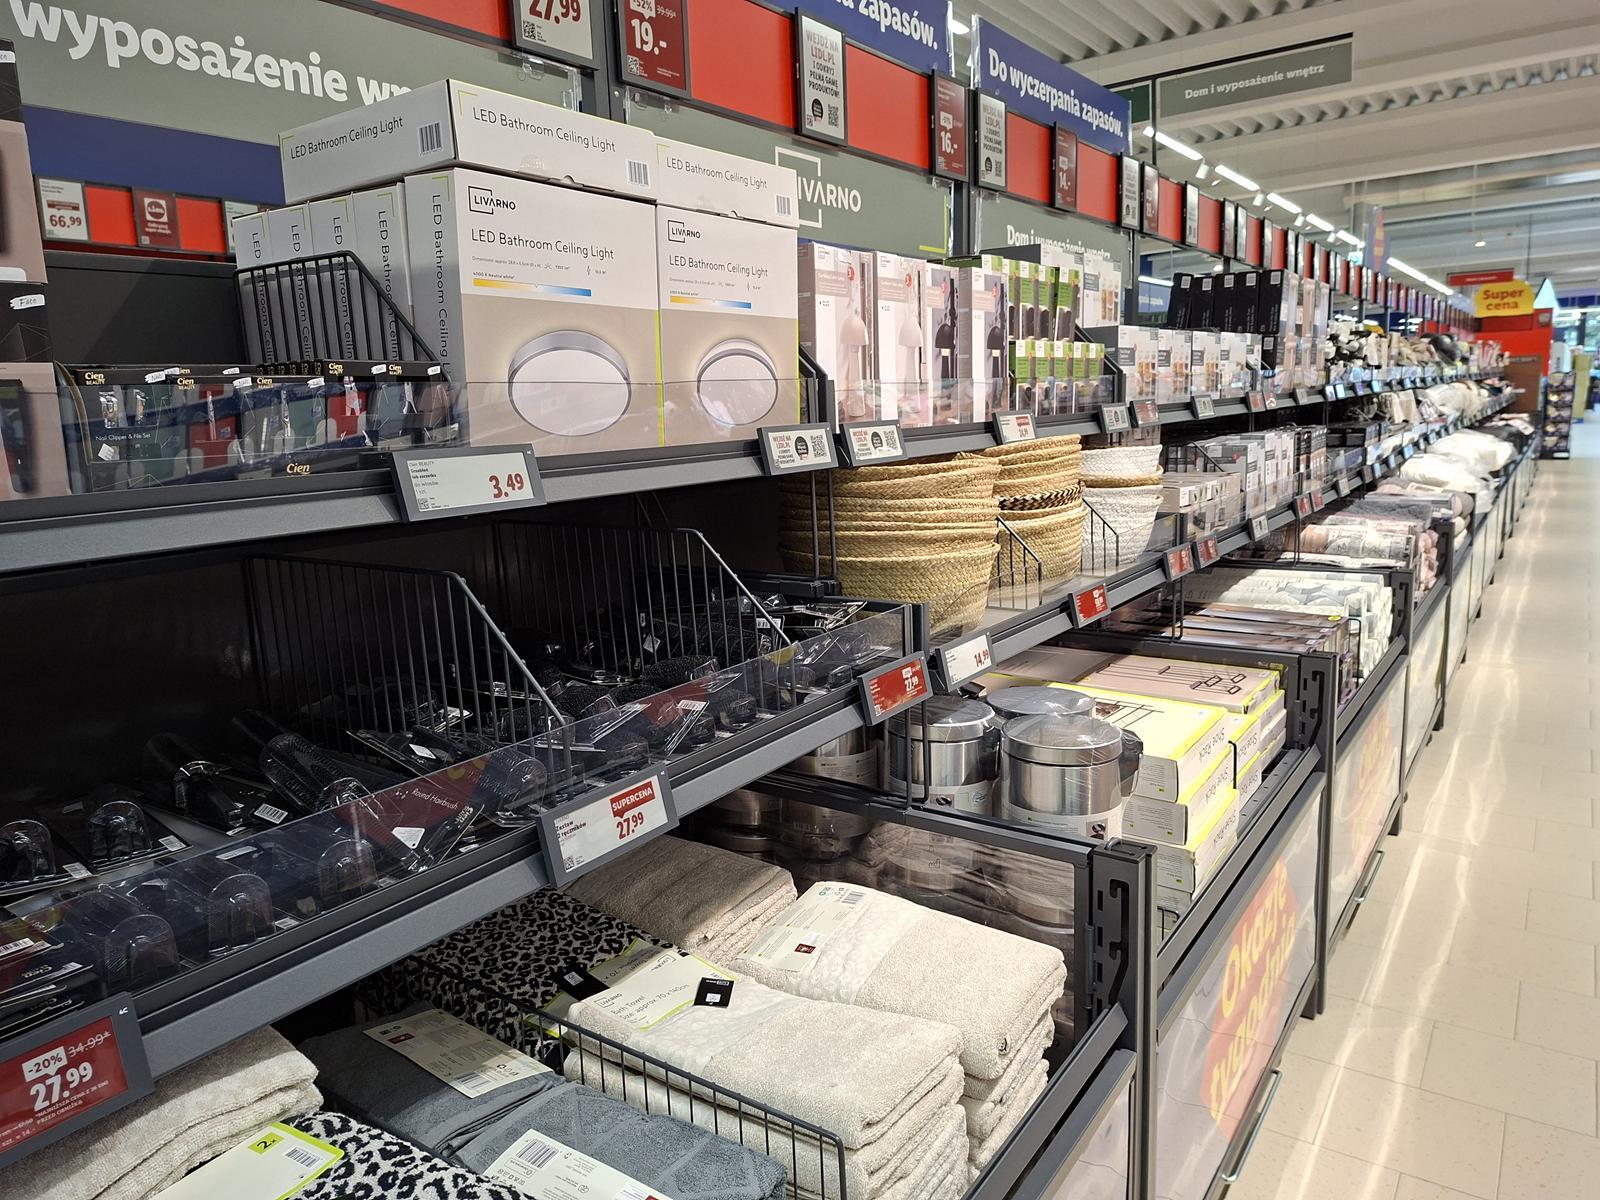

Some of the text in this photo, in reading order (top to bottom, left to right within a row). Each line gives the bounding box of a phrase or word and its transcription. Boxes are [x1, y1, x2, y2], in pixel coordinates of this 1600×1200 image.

[10, 0, 348, 102] wyposażenie
[631, 18, 667, 55] 19.-
[989, 47, 1007, 82] Do
[1010, 66, 1080, 117] wyczerpania
[1082, 102, 1123, 138] zapasów.
[1184, 64, 1325, 99] Dom i wyposażenie wnętrz
[290, 116, 403, 159] LED Bathroom Ceiling Light
[473, 106, 616, 153] LED Bathroom Ceiling Light
[666, 156, 768, 190] LED Bathroom Ceiling Light
[432, 194, 442, 225] LED
[474, 195, 516, 211] LIVARNO
[50, 214, 82, 228] 66.99
[332, 216, 343, 245] LED
[378, 210, 388, 241] LED
[671, 227, 701, 239] LIVARNO
[1007, 225, 1029, 246] Dom
[251, 232, 262, 259] LED
[291, 224, 301, 253] LED
[471, 229, 614, 260] LED Bathroom Ceiling Light
[434, 230, 445, 304] Bathroom
[669, 255, 768, 279] LED Bathroom Ceiling Light
[1483, 289, 1524, 311] Super cena
[438, 308, 448, 357] Ceiling
[85, 371, 104, 380] Cien
[177, 377, 195, 386] Cien
[257, 377, 272, 385] Cien
[287, 463, 311, 475] Cien
[489, 473, 524, 498] 3.49
[412, 788, 431, 801] Round
[612, 787, 653, 811] SUPERCENA
[616, 811, 644, 840] 27.99
[1222, 860, 1288, 1019] Okazje
[28, 1053, 62, 1073] -20%
[30, 1061, 93, 1112] 27.99
